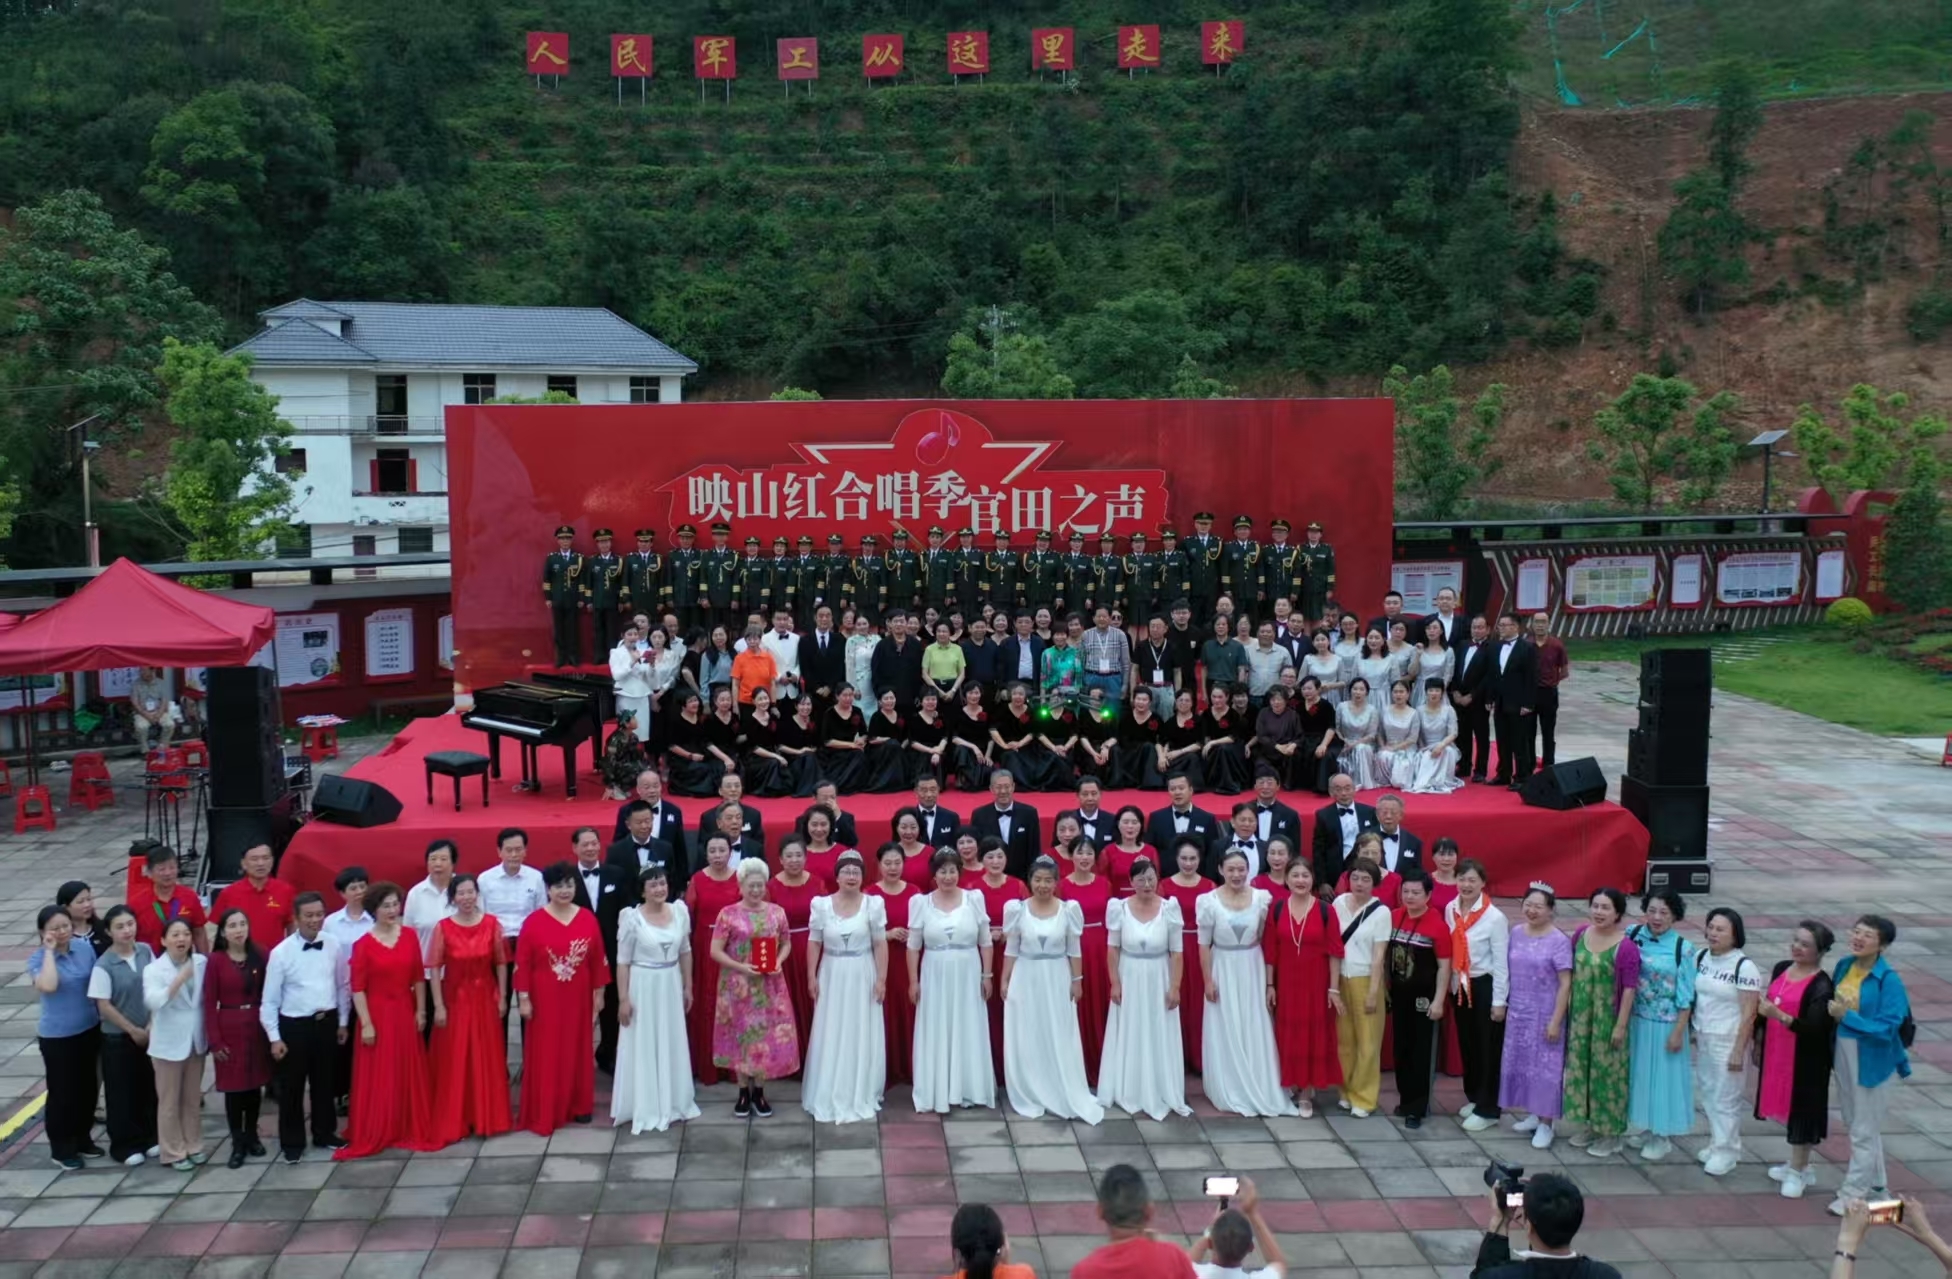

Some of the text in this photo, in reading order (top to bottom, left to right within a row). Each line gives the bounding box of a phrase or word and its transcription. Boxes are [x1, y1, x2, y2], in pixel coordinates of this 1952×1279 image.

[530, 22, 1235, 75] 人民军工从这里走来
[688, 469, 1146, 535] 映山红合唱季官田之声
